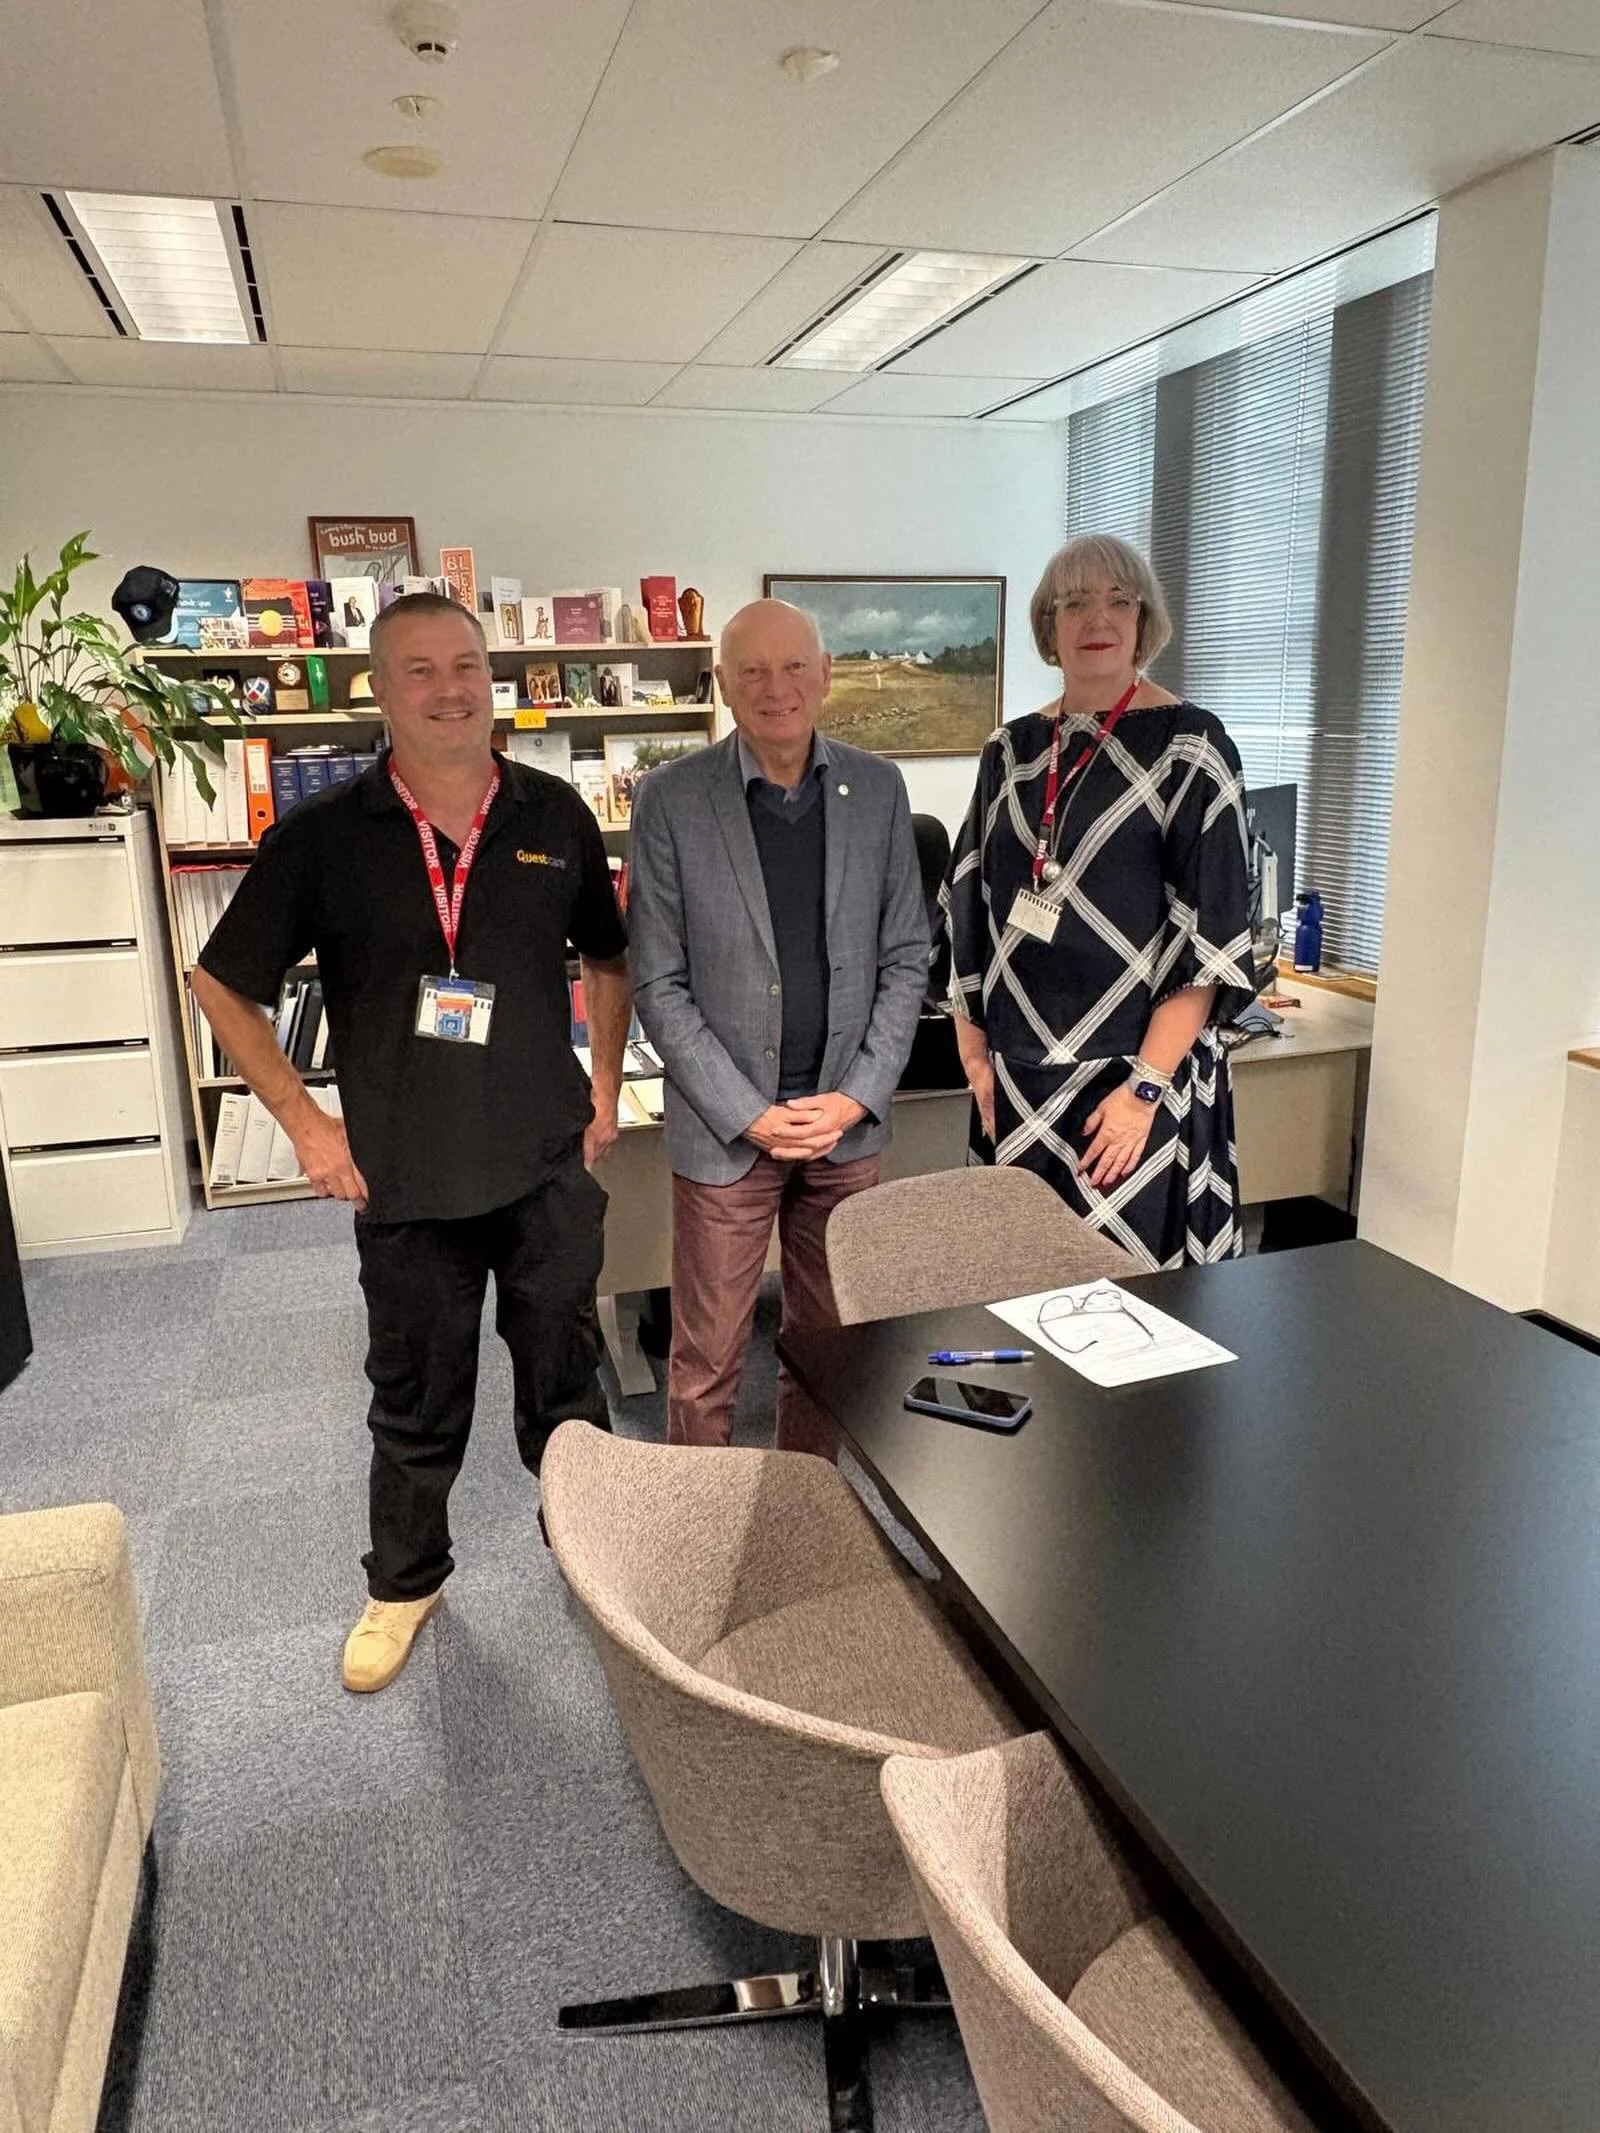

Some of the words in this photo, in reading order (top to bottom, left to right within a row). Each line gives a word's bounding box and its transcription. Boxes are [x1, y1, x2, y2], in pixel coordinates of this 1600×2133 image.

[328, 526, 365, 548] bush
[368, 527, 398, 545] bud
[390, 771, 419, 811] VISITOR
[479, 775, 501, 816] VISITOR
[417, 819, 441, 869] VISITOR
[457, 827, 482, 869] VISITOR
[433, 883, 453, 933] VISITOR
